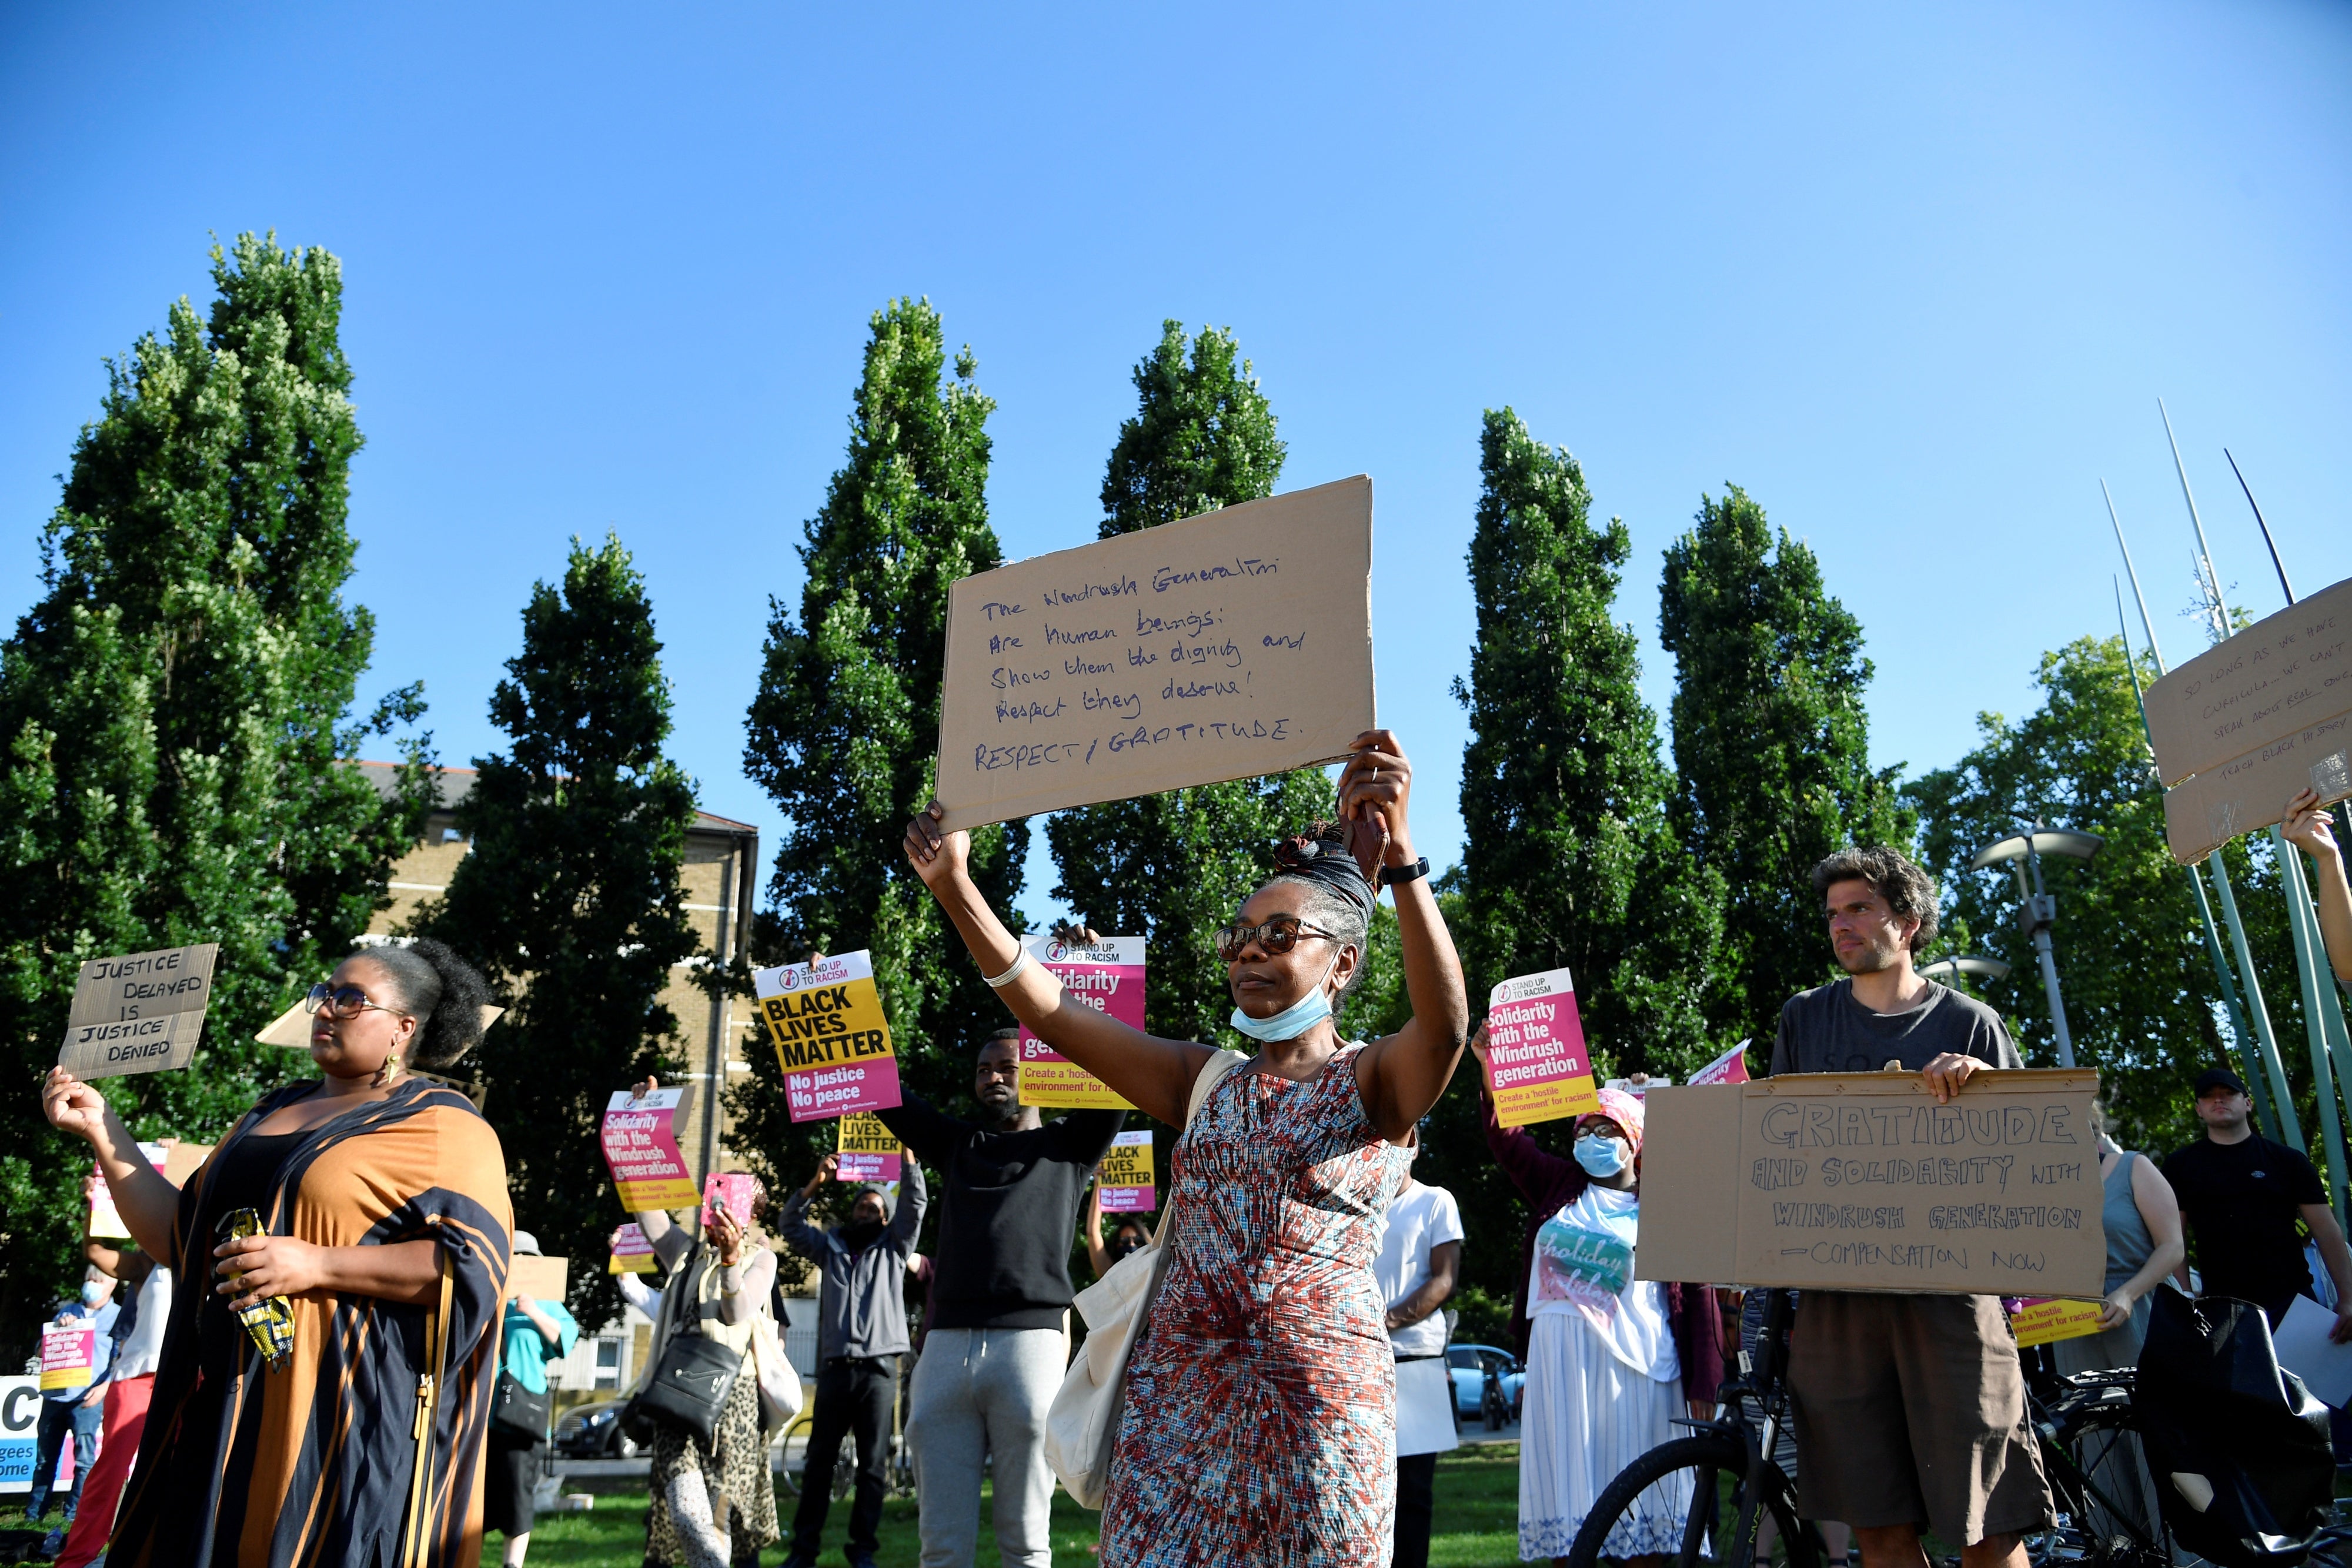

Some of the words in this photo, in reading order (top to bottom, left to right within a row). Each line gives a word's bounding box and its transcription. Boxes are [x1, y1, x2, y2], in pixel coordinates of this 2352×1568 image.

[980, 602, 1026, 621] The
[990, 636, 1024, 654] Are
[1045, 624, 1117, 645] human
[991, 667, 1050, 689] Show
[1065, 657, 1115, 674] them
[1128, 648, 1158, 666] the
[1262, 631, 1305, 650] and
[2184, 681, 2201, 701] SO
[2210, 657, 2243, 684] LONG
[2253, 647, 2270, 664] AS
[2278, 634, 2296, 648] WE
[2307, 617, 2336, 638] HAVE
[2283, 660, 2300, 675] WE
[2310, 641, 2345, 662] CAN'T
[1083, 688, 1140, 719] they
[2214, 717, 2244, 740] SPEAK
[2253, 698, 2282, 723] ABOUT
[2287, 688, 2313, 708] REAL
[2324, 671, 2352, 688] EDUC
[2219, 759, 2254, 781] TEACH
[2263, 739, 2295, 762] BLACK
[2303, 718, 2347, 744] HISTORY
[1071, 943, 1100, 952] STAND
[1102, 944, 1114, 952] UP
[1071, 952, 1083, 961] TO
[1085, 953, 1120, 962] RACISM
[92, 953, 180, 979] JUSTICE
[830, 960, 841, 970] UP
[123, 977, 201, 999] DELAYED
[802, 977, 814, 986] TO
[816, 969, 848, 984] RACISM
[1051, 968, 1120, 995] idarity
[1512, 979, 1534, 991] STAND
[1535, 978, 1545, 986] UP
[1514, 991, 1523, 999] TO
[1524, 985, 1552, 997] RACISM
[121, 1005, 139, 1022] IS
[766, 986, 853, 1021] BLACK
[1488, 1002, 1555, 1028] Solidarity
[79, 1019, 164, 1043] JUSTICE
[774, 1013, 847, 1042] LIVES
[1489, 1027, 1521, 1047] with
[1523, 1022, 1549, 1040] the
[108, 1041, 170, 1061] DENIED
[782, 1029, 886, 1068] MATTER
[1489, 1037, 1565, 1065] Windrush
[790, 1074, 811, 1091] No
[814, 1067, 866, 1090] justice
[1025, 1067, 1056, 1078] Create
[1067, 1068, 1096, 1079] 'host
[1494, 1057, 1578, 1088] generation
[1694, 1061, 1730, 1085] lidarity
[791, 1091, 812, 1108] No
[816, 1086, 860, 1108] peace
[1024, 1081, 1086, 1092] environment'
[1089, 1081, 1101, 1092] for
[1499, 1092, 1524, 1103] Create
[1531, 1086, 1559, 1098] 'hostile
[1551, 1097, 1562, 1105] for
[1565, 1092, 1592, 1103] racism
[605, 1113, 659, 1132] Solidarity
[844, 1123, 881, 1135] LIVES
[1761, 1102, 2077, 1149] GRATITUDE
[604, 1131, 629, 1146] with
[631, 1130, 652, 1145] the
[842, 1137, 898, 1151] MATTER
[606, 1145, 666, 1162] Windrush
[854, 1154, 884, 1165] justice
[614, 1161, 679, 1180] generation
[1101, 1160, 1134, 1172] LIVES
[1751, 1158, 1808, 1190] AND
[1822, 1155, 2014, 1194] SOLIDARITY
[2032, 1163, 2080, 1185] WITH
[1101, 1172, 1151, 1185] MATTER
[1773, 1202, 1905, 1228] WINDRUSH
[1929, 1203, 2082, 1229] GENERATION
[1542, 1232, 1622, 1278] holiday
[1992, 1250, 2045, 1272] NOW
[2011, 1315, 2026, 1323] eate
[2014, 1319, 2054, 1334] vironment'
[2070, 1311, 2097, 1322] racism
[45, 1332, 85, 1344] Solidarity
[2, 1386, 39, 1431] C
